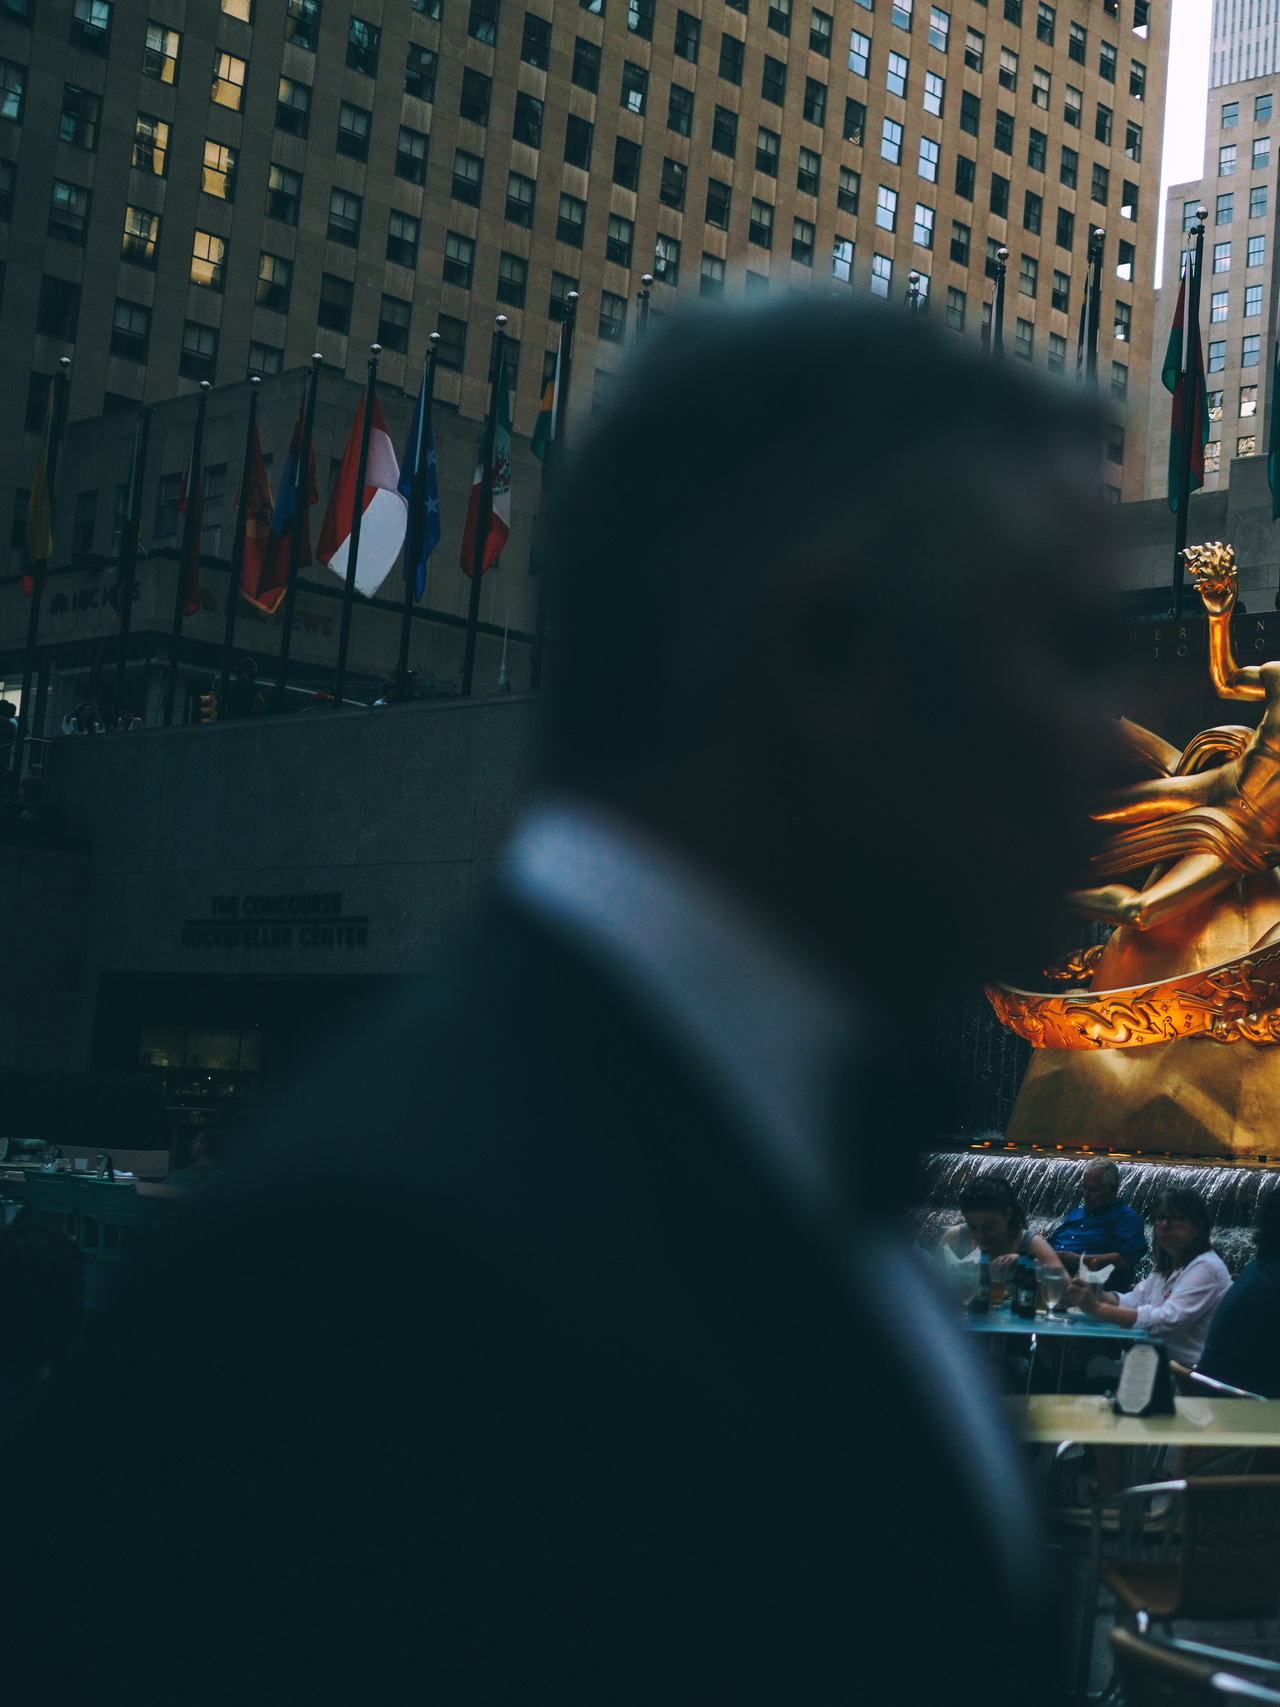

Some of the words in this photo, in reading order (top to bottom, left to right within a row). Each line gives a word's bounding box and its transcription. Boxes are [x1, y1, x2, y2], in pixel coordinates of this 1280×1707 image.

[73, 587, 100, 611] NBC
[102, 581, 140, 607] NS
[210, 895, 240, 915] THE
[243, 894, 342, 915] CONCOURSE
[181, 927, 293, 948] ROCKEFELLER
[299, 927, 368, 947] CENTER
